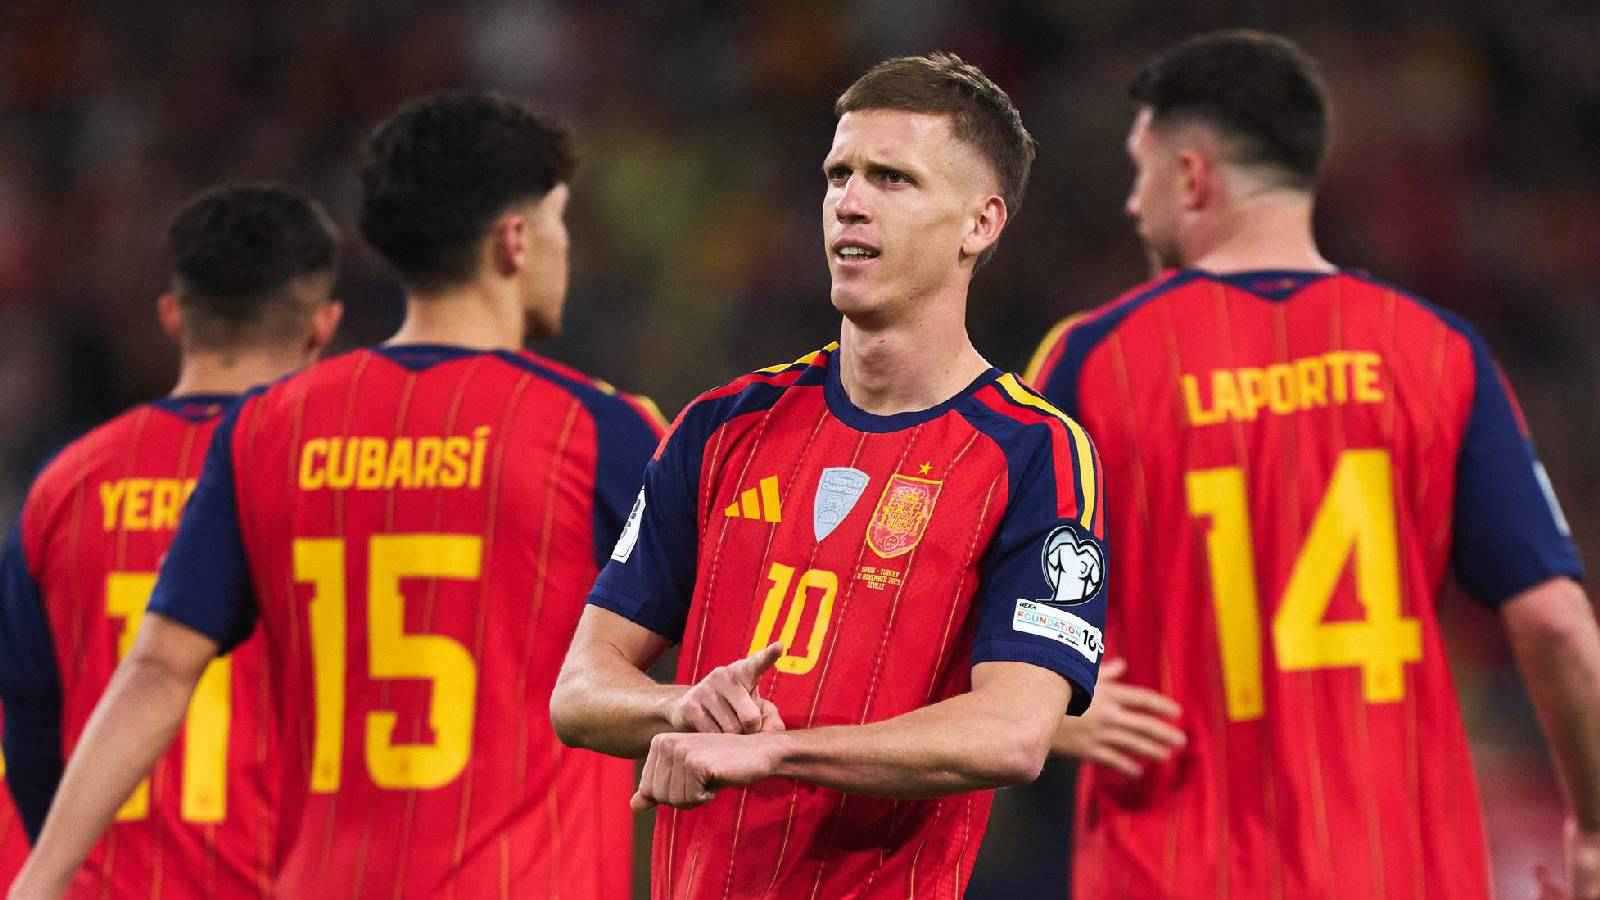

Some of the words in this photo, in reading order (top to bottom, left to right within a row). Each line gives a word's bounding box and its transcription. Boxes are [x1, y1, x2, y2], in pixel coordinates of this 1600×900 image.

[299, 425, 490, 490] CUBARSÍ
[1182, 350, 1385, 427] LAPORTE
[292, 533, 484, 793] 15
[748, 562, 838, 674] 10
[1184, 448, 1423, 721] 14
[106, 571, 232, 823] 1
